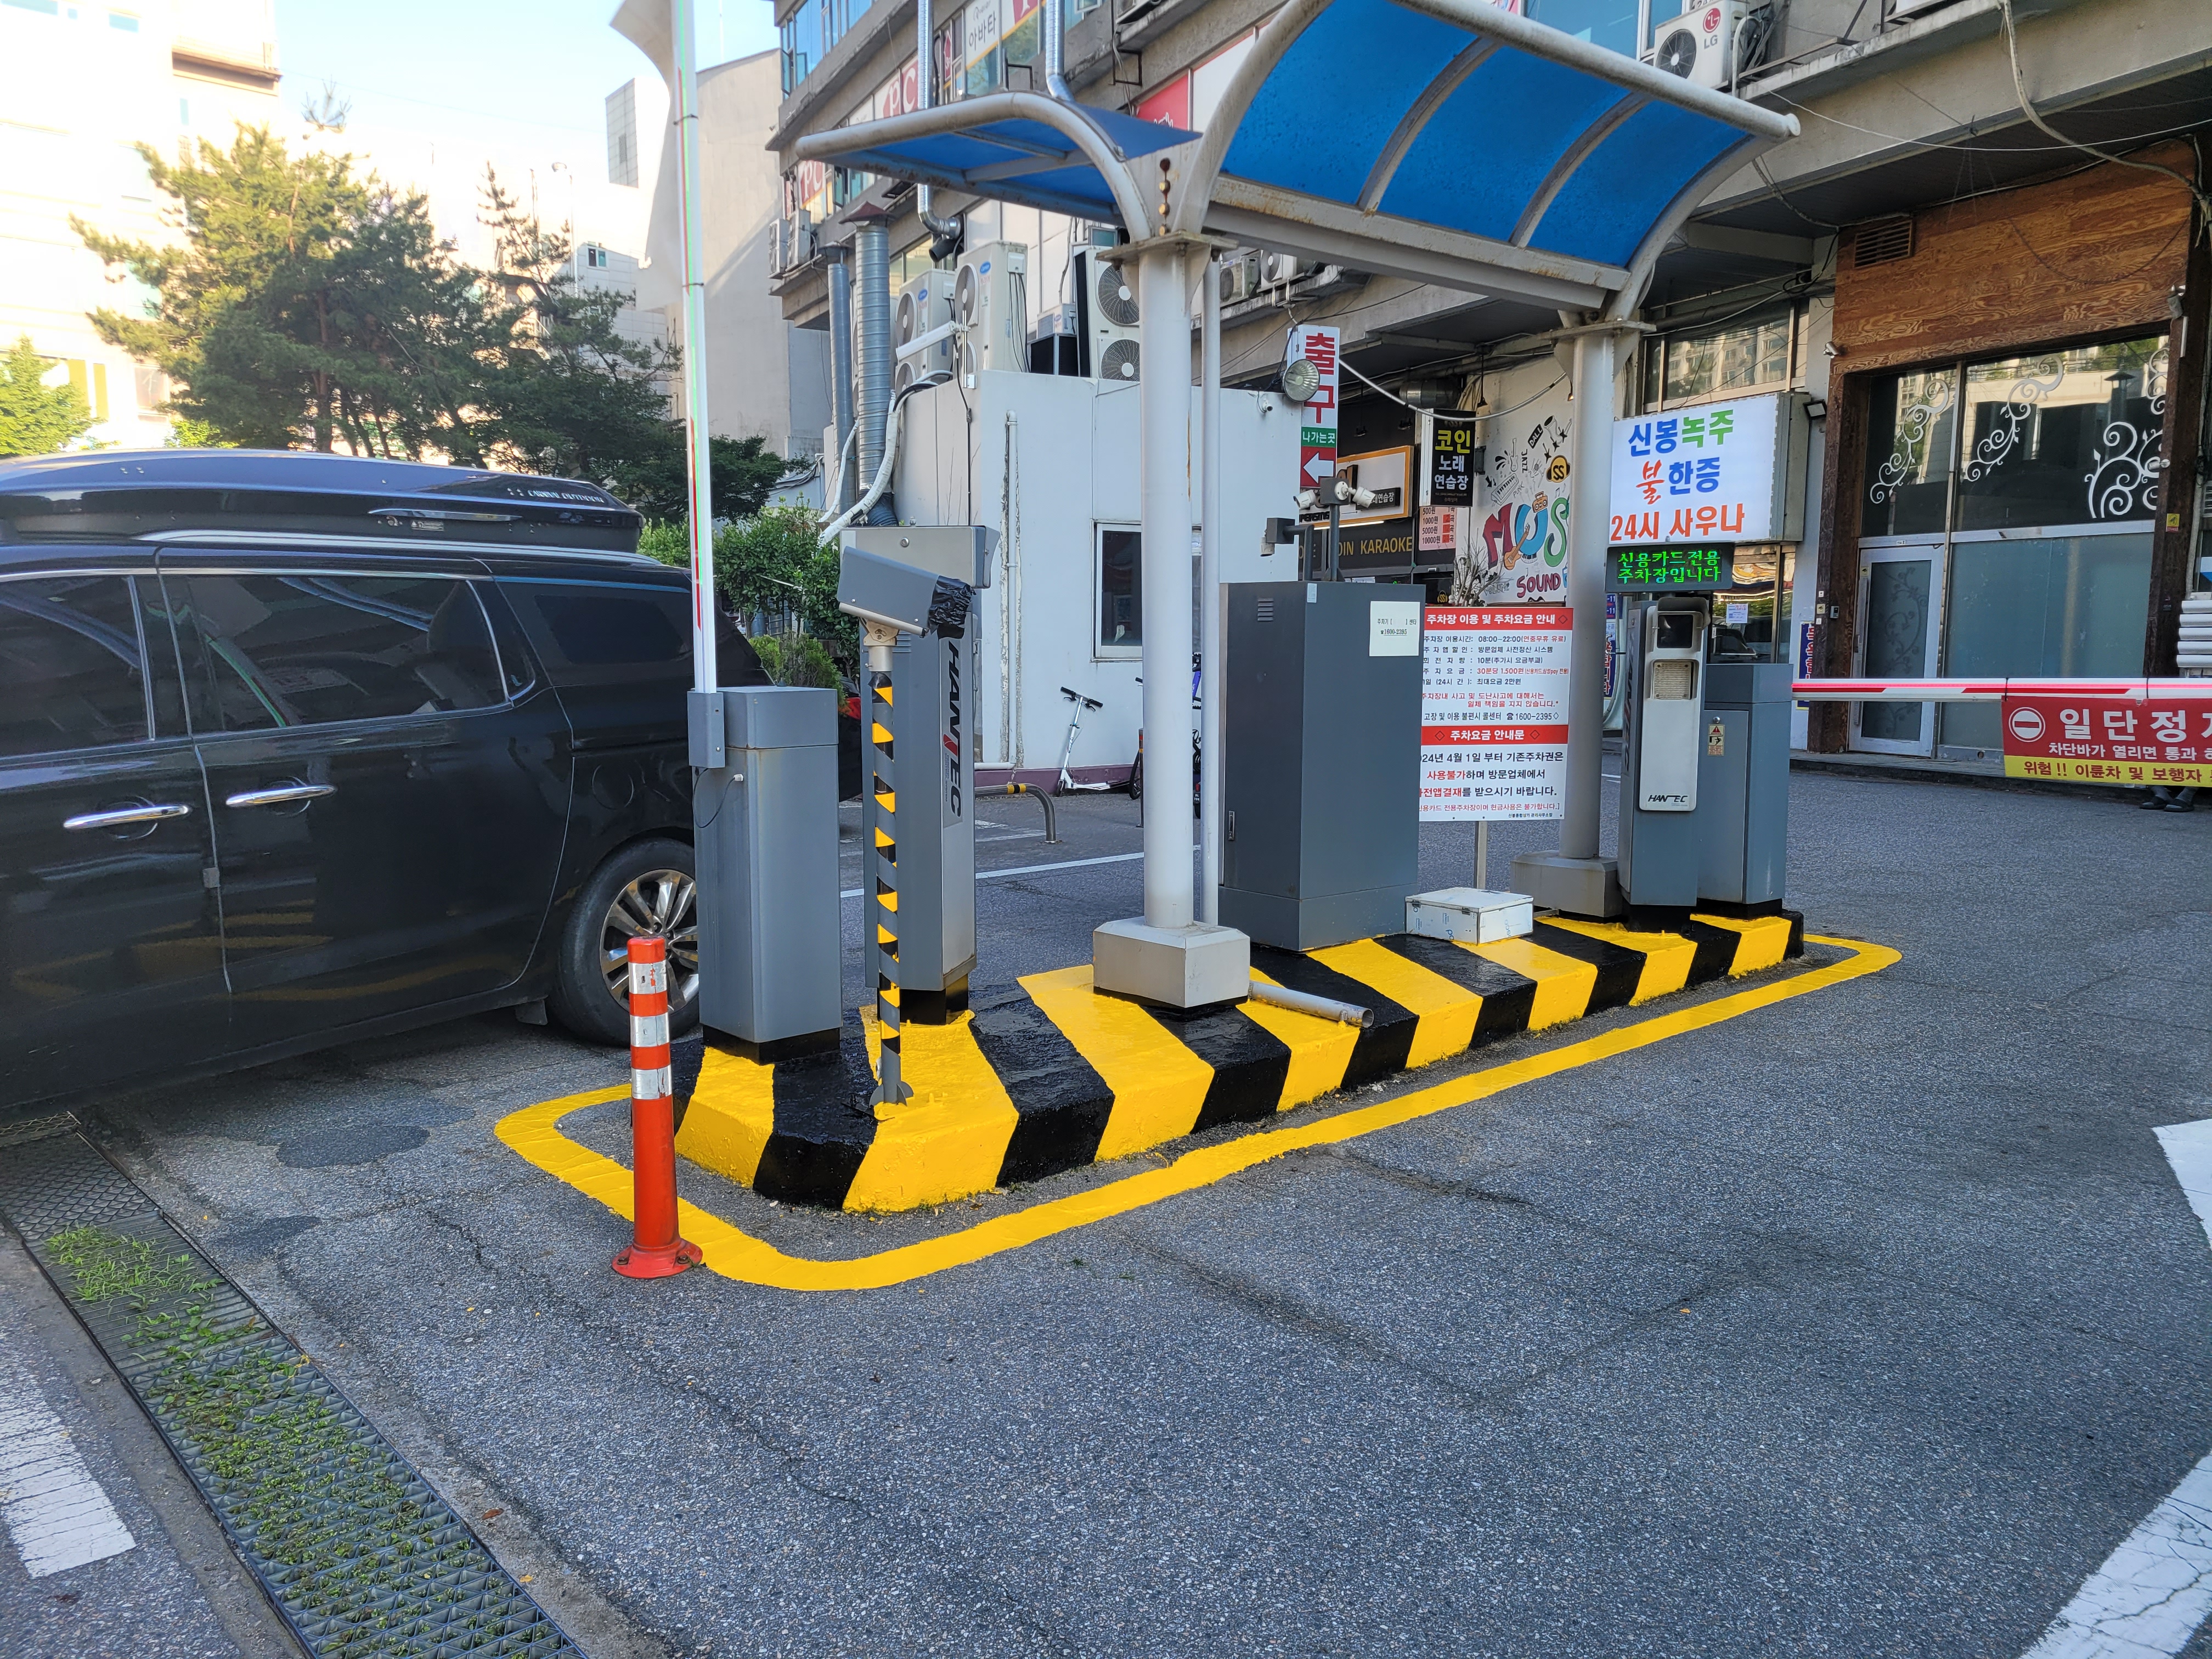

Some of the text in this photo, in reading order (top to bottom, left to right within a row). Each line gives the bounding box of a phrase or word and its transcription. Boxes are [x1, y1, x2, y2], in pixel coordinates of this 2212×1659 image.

[969, 10, 996, 51] 아바타
[1704, 35, 1718, 49] LG
[1304, 332, 1336, 424] 출구
[1302, 432, 1335, 444] 나가는곳
[1628, 409, 1734, 457] 신봉녹주
[1435, 430, 1470, 453] 코인
[1438, 455, 1464, 472] 노래
[1434, 474, 1469, 490] 연습장
[1423, 506, 1435, 515] 500원
[1423, 516, 1438, 524] 1000원
[1610, 503, 1745, 541] 24시 사우나
[1422, 526, 1437, 534] 5000원
[1482, 497, 1569, 570] MUS
[1361, 537, 1413, 555] KARAOKE
[1422, 535, 1440, 544] 10000원
[1618, 566, 1721, 584] 주차장입니다
[1517, 573, 1561, 598] SOUND
[1427, 613, 1555, 625] 주차장 이용 및 주차요금 안내
[1439, 712, 1445, 720] 및
[1447, 712, 1460, 720] 이용
[1462, 712, 1480, 720] 불편시
[1483, 712, 1501, 720] 콜센터
[943, 640, 961, 818] HANTEC
[1450, 730, 1525, 741] 주차요금 안내문
[1421, 752, 1564, 763] 24년 4월 1일 부터 기존주차권은
[2049, 742, 2106, 758] 차단바가
[2112, 745, 2157, 760] 열리면
[2165, 747, 2197, 761] 통과
[1427, 769, 1545, 780] 사용불가하며 방문업체에서
[2024, 761, 2052, 776] 위험
[2075, 764, 2121, 779] 이륜차
[2129, 766, 2143, 781] 및
[2152, 768, 2202, 783] 보행자
[1475, 787, 1513, 797] 받으시기
[1516, 786, 1557, 796] 바랍니다.
